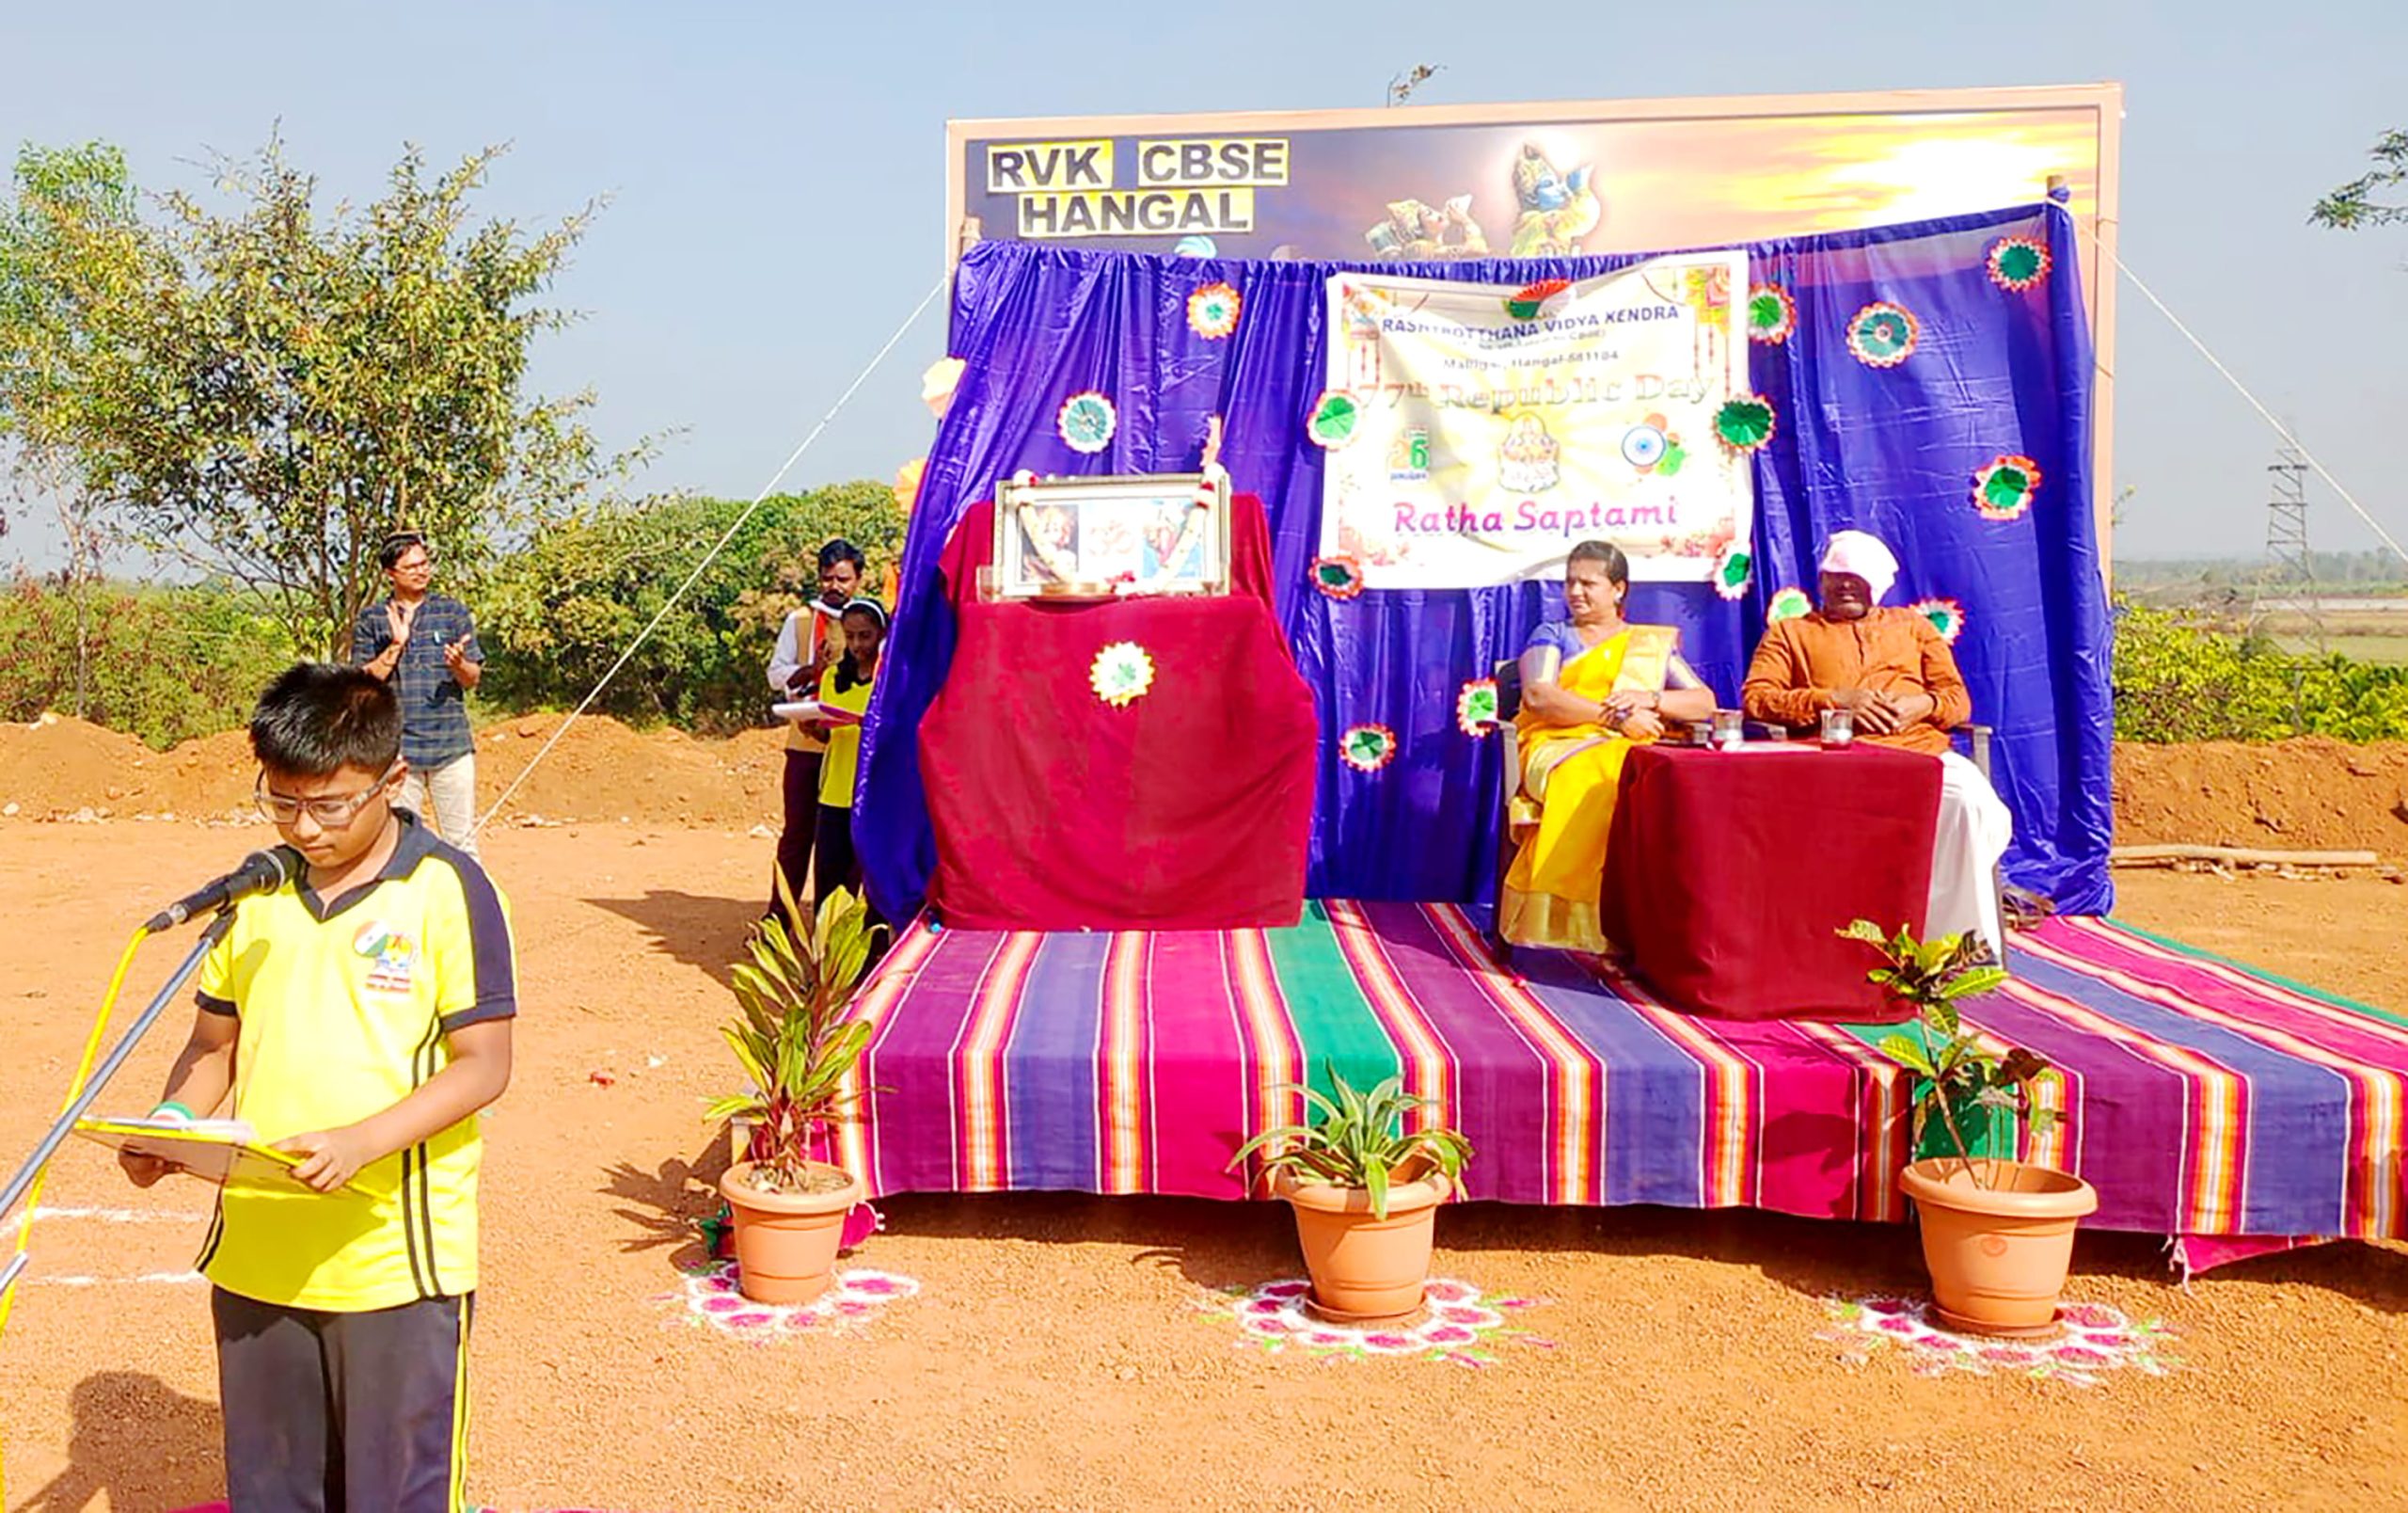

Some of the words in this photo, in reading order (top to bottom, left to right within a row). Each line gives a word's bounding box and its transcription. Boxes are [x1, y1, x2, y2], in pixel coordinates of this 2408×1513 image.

[990, 146, 1103, 187] RVK
[1142, 142, 1285, 182] CBSE
[1022, 192, 1249, 232] HANGAL
[1545, 313, 1600, 332] VIDYA
[1605, 305, 1679, 325] KENDRA
[1439, 376, 1623, 415] Republic
[1634, 374, 1716, 406] Day
[1392, 501, 1504, 534] Ratha
[1513, 495, 1678, 538] Saptami
